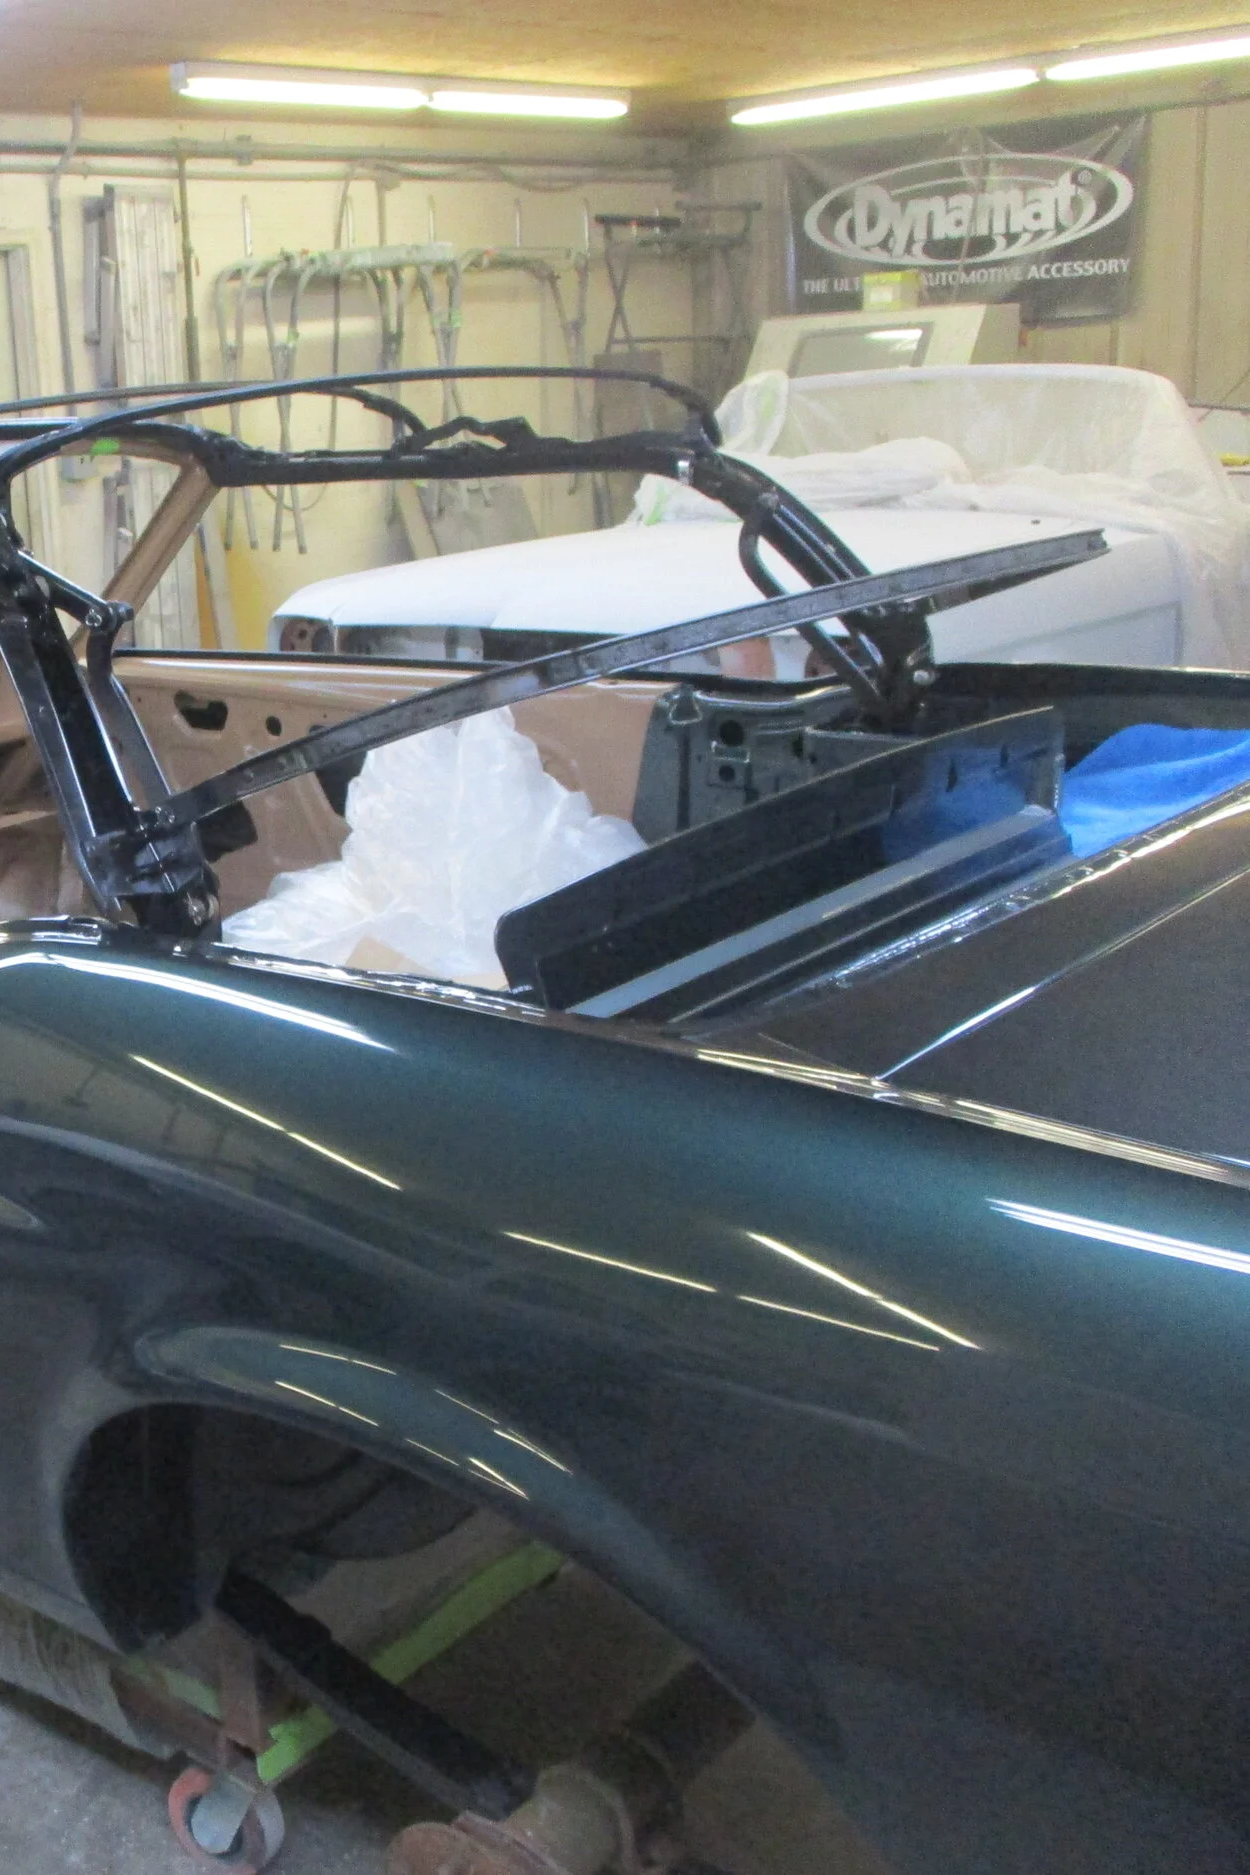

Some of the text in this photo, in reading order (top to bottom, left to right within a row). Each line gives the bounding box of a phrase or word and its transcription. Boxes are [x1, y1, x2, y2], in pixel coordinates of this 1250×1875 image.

[853, 169, 1087, 257] Dynamat
[803, 279, 827, 294] THE
[1028, 257, 1131, 280] ACCESSORY
